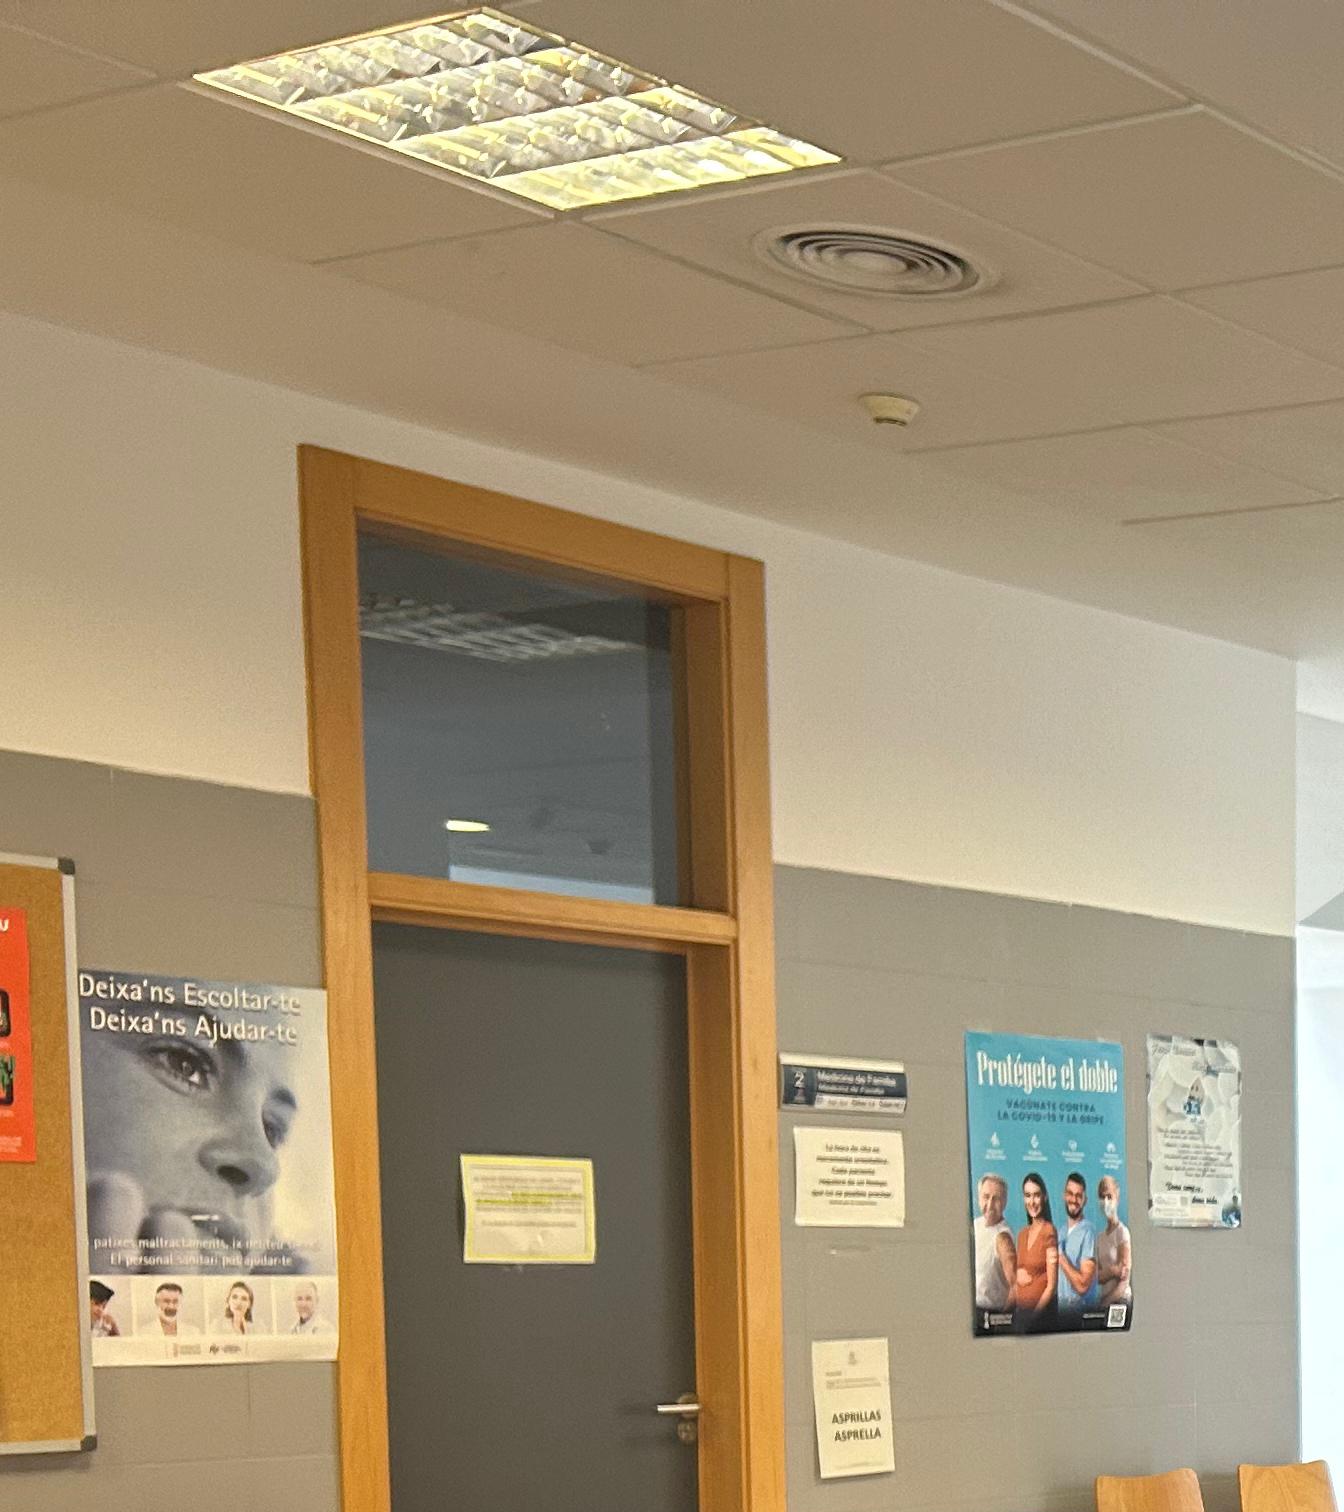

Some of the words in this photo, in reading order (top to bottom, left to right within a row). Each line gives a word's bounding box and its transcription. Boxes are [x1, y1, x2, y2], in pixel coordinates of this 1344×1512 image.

[78, 973, 175, 1004] Deixa'ns
[184, 982, 300, 1015] Escoltar-te
[90, 1006, 186, 1036] Deixa'ns
[195, 1015, 298, 1049] Ajudar-te
[976, 1051, 1057, 1095] Protégete
[1061, 1057, 1075, 1091] el
[1079, 1058, 1118, 1093] doble
[1059, 1103, 1096, 1113] CONTRA
[997, 1111, 1009, 1121] LA
[1012, 1112, 1056, 1122] COVID-19
[1067, 1115, 1077, 1124] LA
[1080, 1115, 1104, 1125] GRIPE
[832, 1409, 881, 1424] ASPRILLAS
[834, 1427, 881, 1441] ASPRELLA
